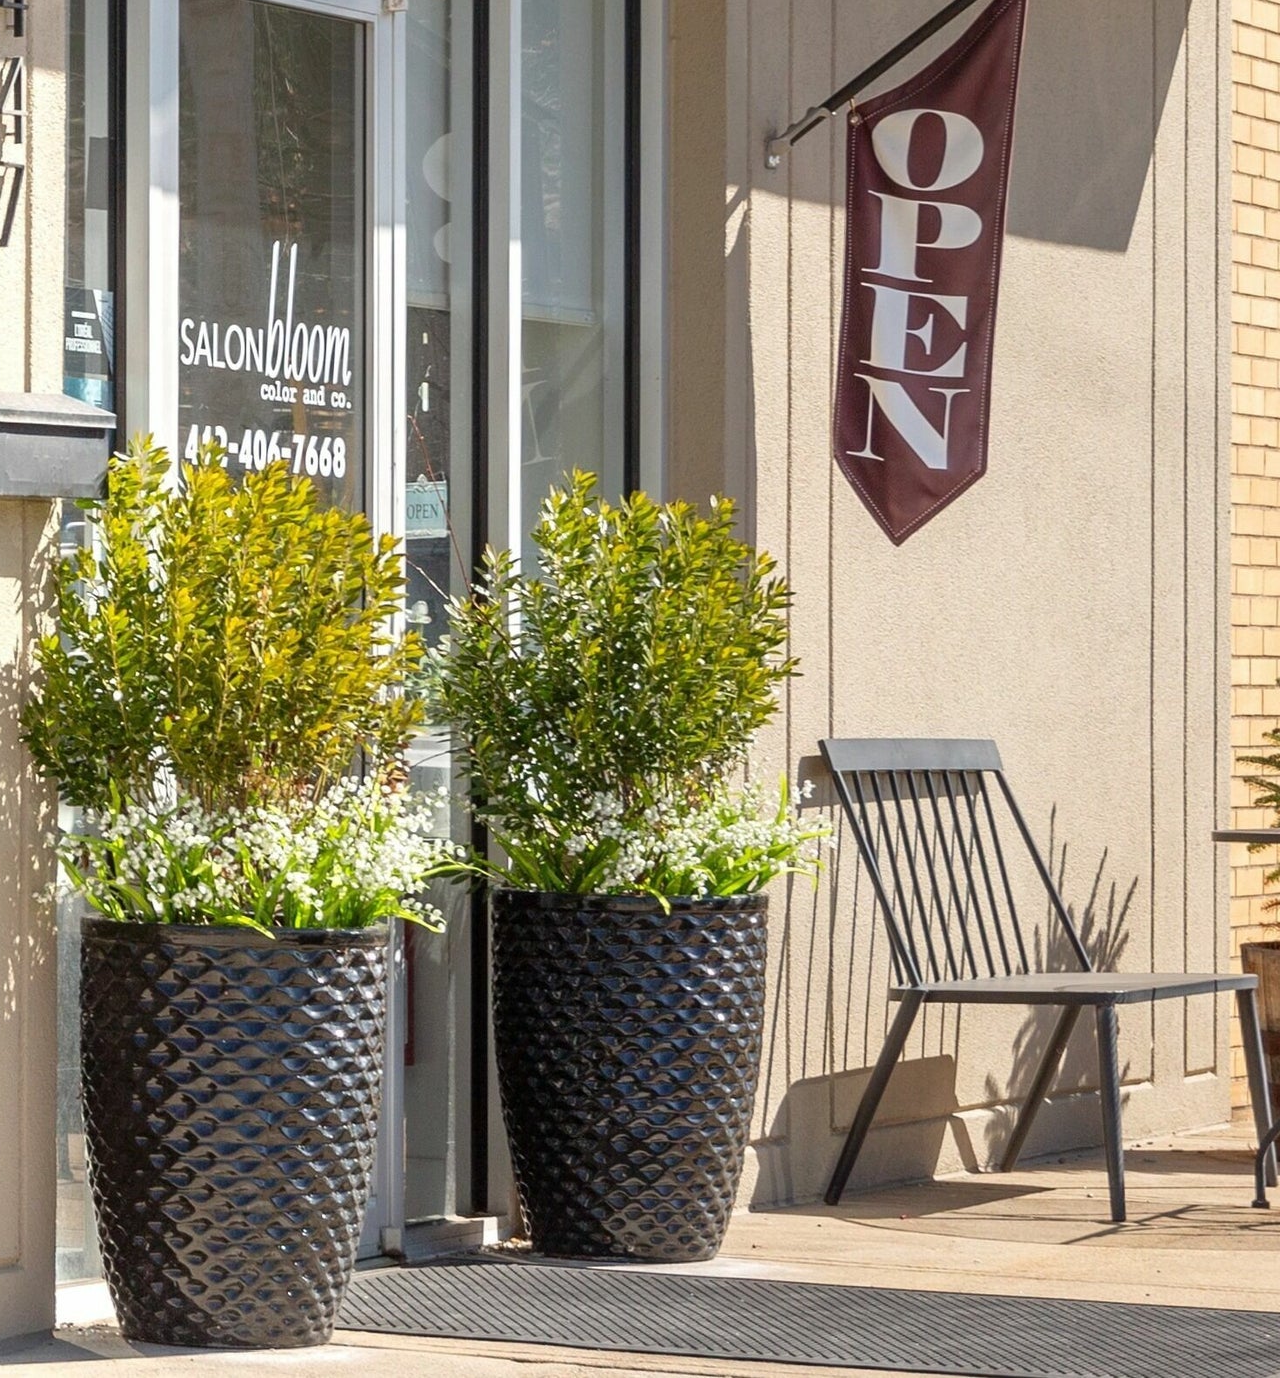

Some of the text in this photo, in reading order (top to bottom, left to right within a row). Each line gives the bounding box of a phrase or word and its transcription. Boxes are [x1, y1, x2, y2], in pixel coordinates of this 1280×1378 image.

[180, 240, 352, 386] SALON bloom
[845, 108, 985, 470] OPEN
[260, 380, 352, 410] color and co.
[406, 503, 439, 520] OPEN
